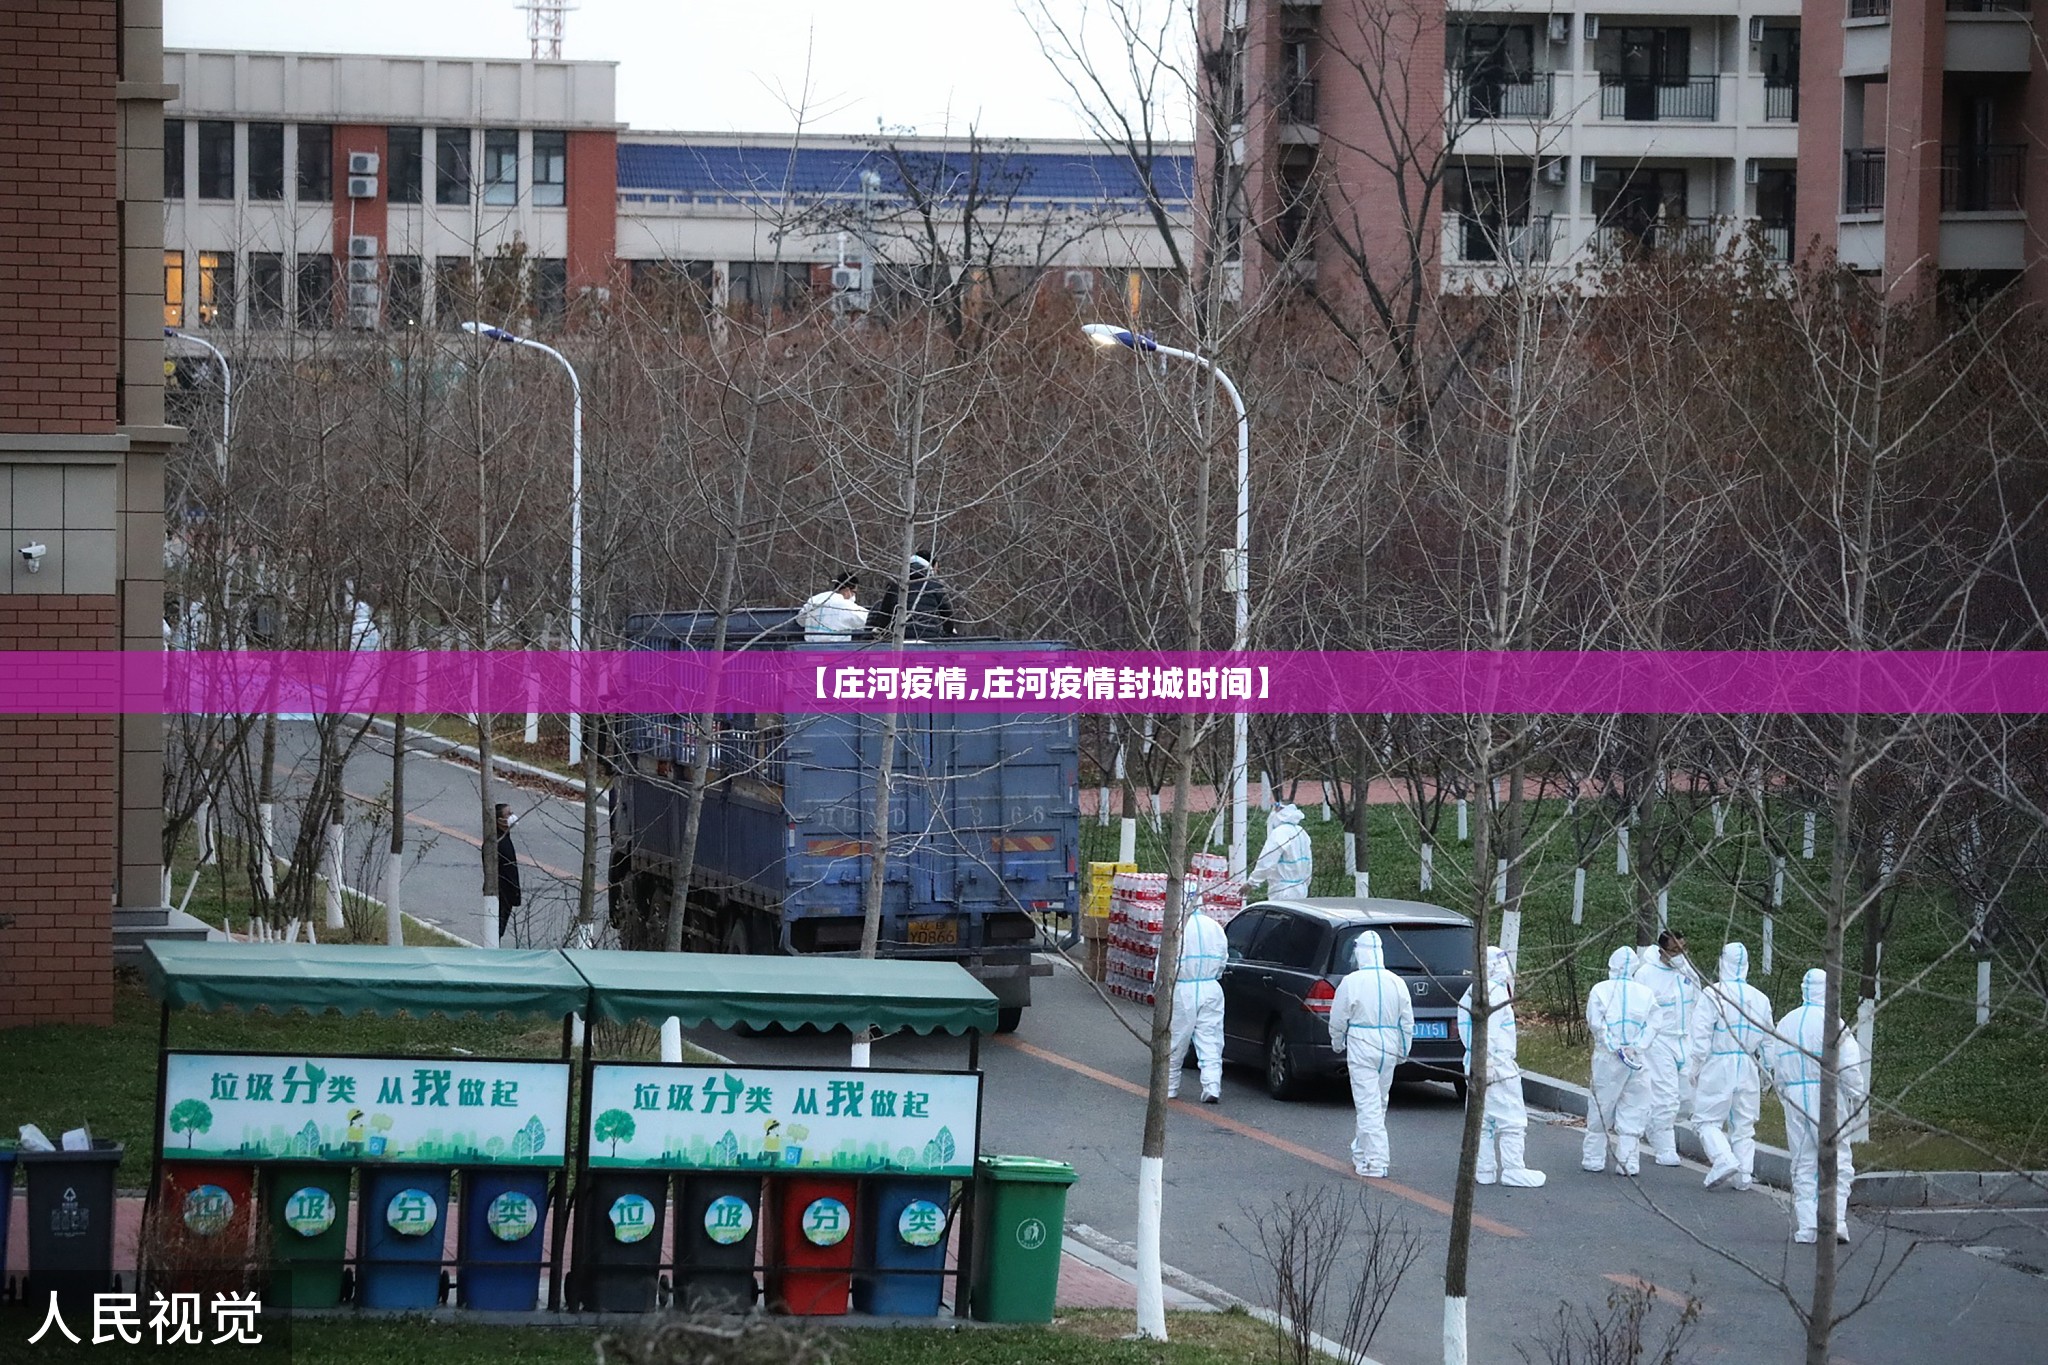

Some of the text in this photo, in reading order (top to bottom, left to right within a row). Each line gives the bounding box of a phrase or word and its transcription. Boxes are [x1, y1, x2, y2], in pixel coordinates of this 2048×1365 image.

[910, 930, 955, 943] YD866
[210, 1061, 519, 1107] 垃圾分类 从我做起
[633, 1071, 930, 1119] 垃圾分类 从我做起
[296, 1194, 325, 1221] 圾
[398, 1197, 427, 1222] 分
[497, 1199, 528, 1224] 类
[616, 1201, 646, 1227] 垃
[713, 1203, 743, 1229] 圾
[811, 1206, 841, 1231] 分
[908, 1209, 938, 1233] 类
